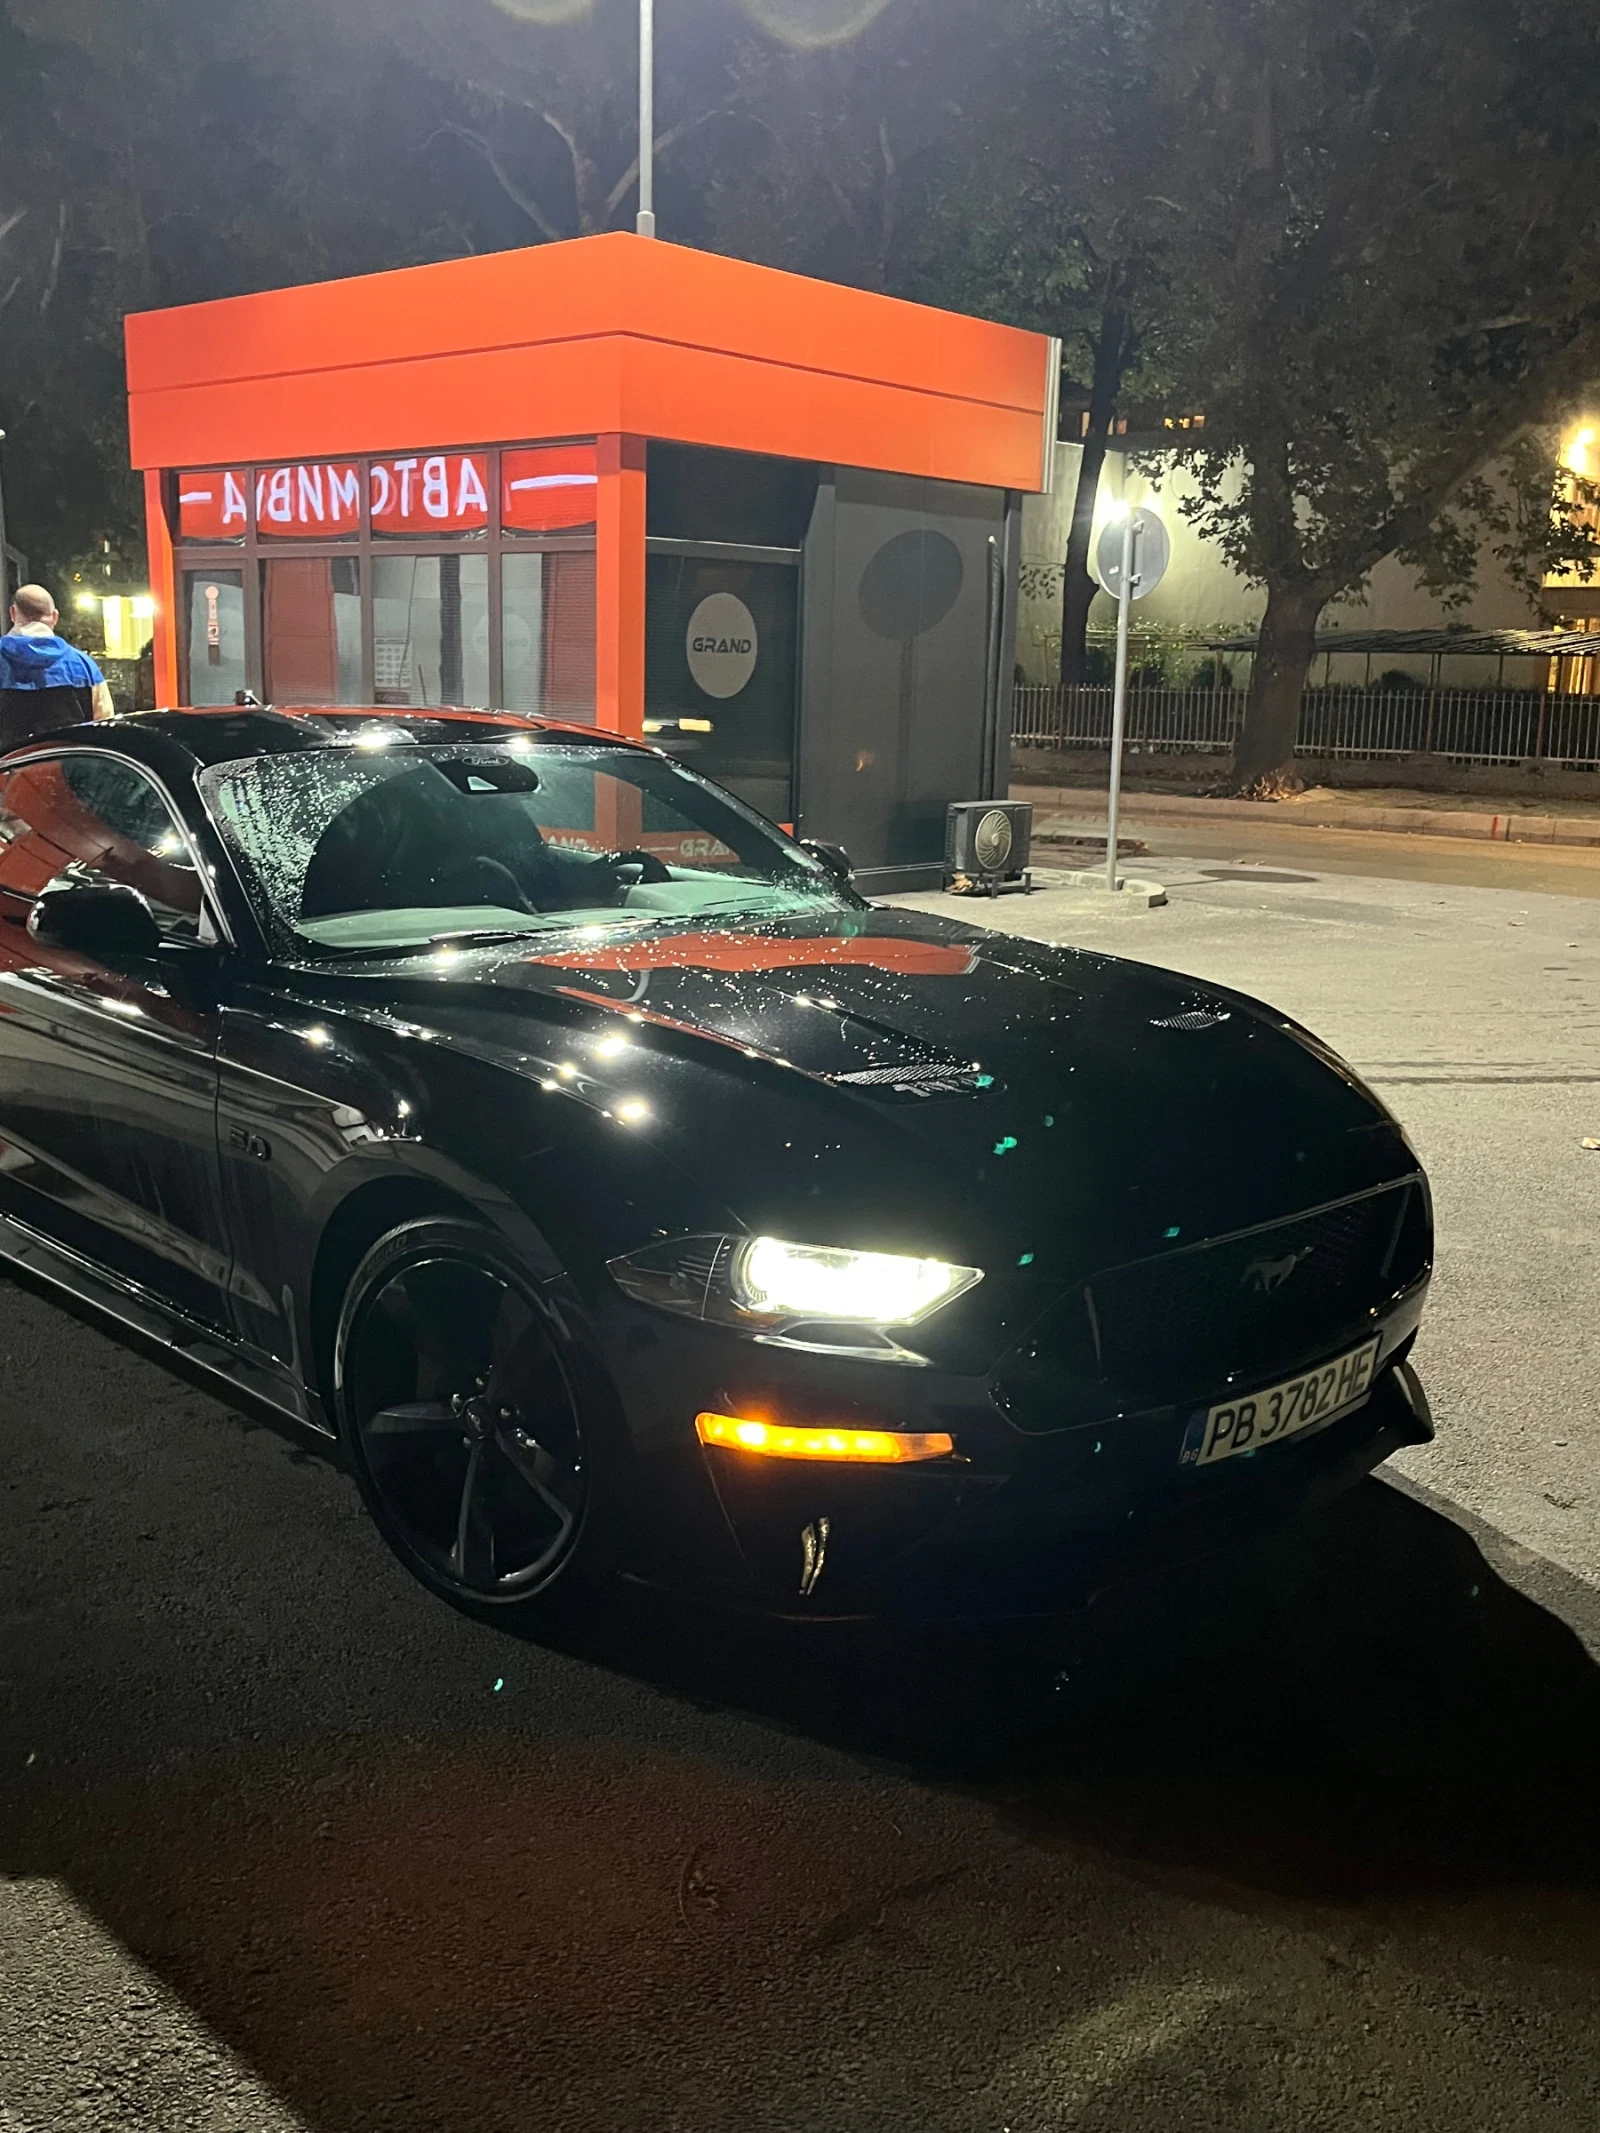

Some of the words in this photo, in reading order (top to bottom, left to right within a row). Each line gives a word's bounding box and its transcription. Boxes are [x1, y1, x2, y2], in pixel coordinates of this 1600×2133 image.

[692, 637, 752, 654] GRAND
[1206, 1402, 1257, 1457] PB
[1181, 1447, 1199, 1464] BG
